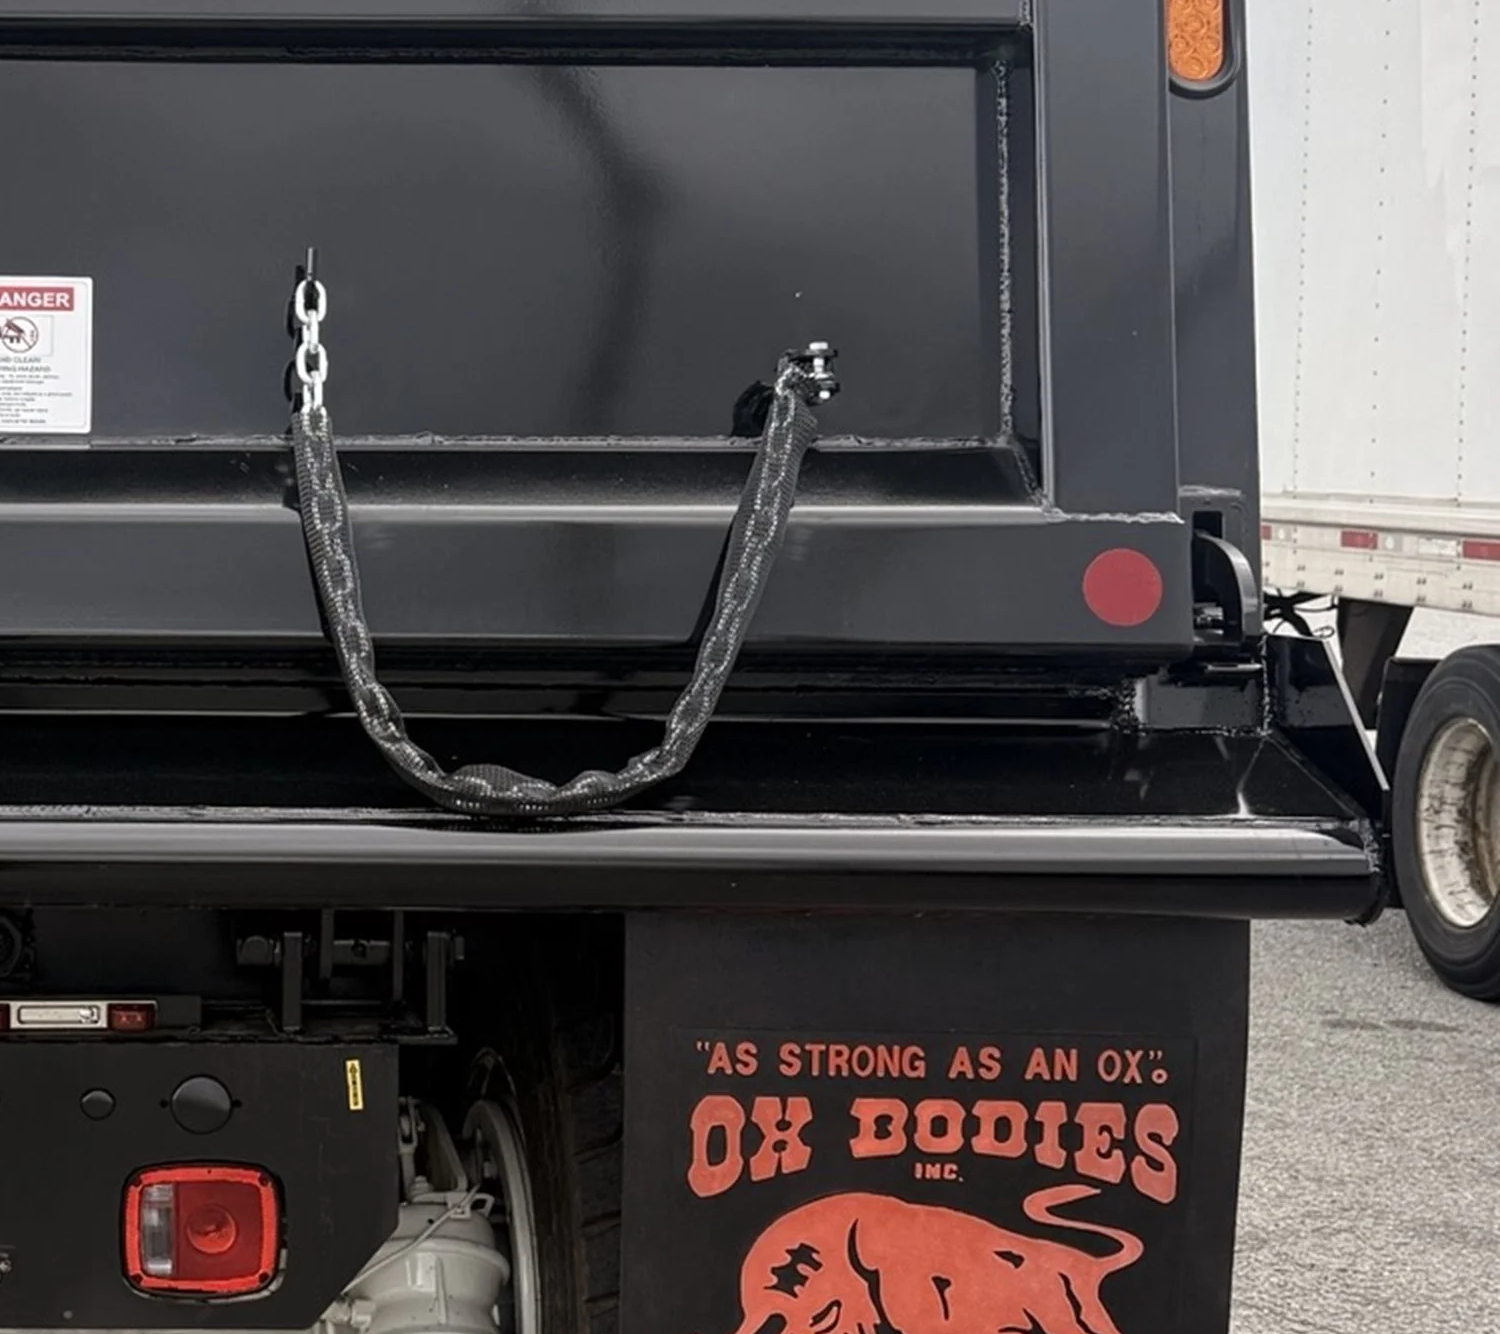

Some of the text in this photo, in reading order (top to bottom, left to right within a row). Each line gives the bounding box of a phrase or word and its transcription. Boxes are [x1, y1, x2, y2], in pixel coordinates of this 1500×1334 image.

[778, 1043, 926, 1079] STRONG
[948, 1045, 1002, 1080] AS
[1024, 1047, 1078, 1082] AN
[687, 1095, 1180, 1204] OX BODIES
[914, 1162, 964, 1183] INC.
